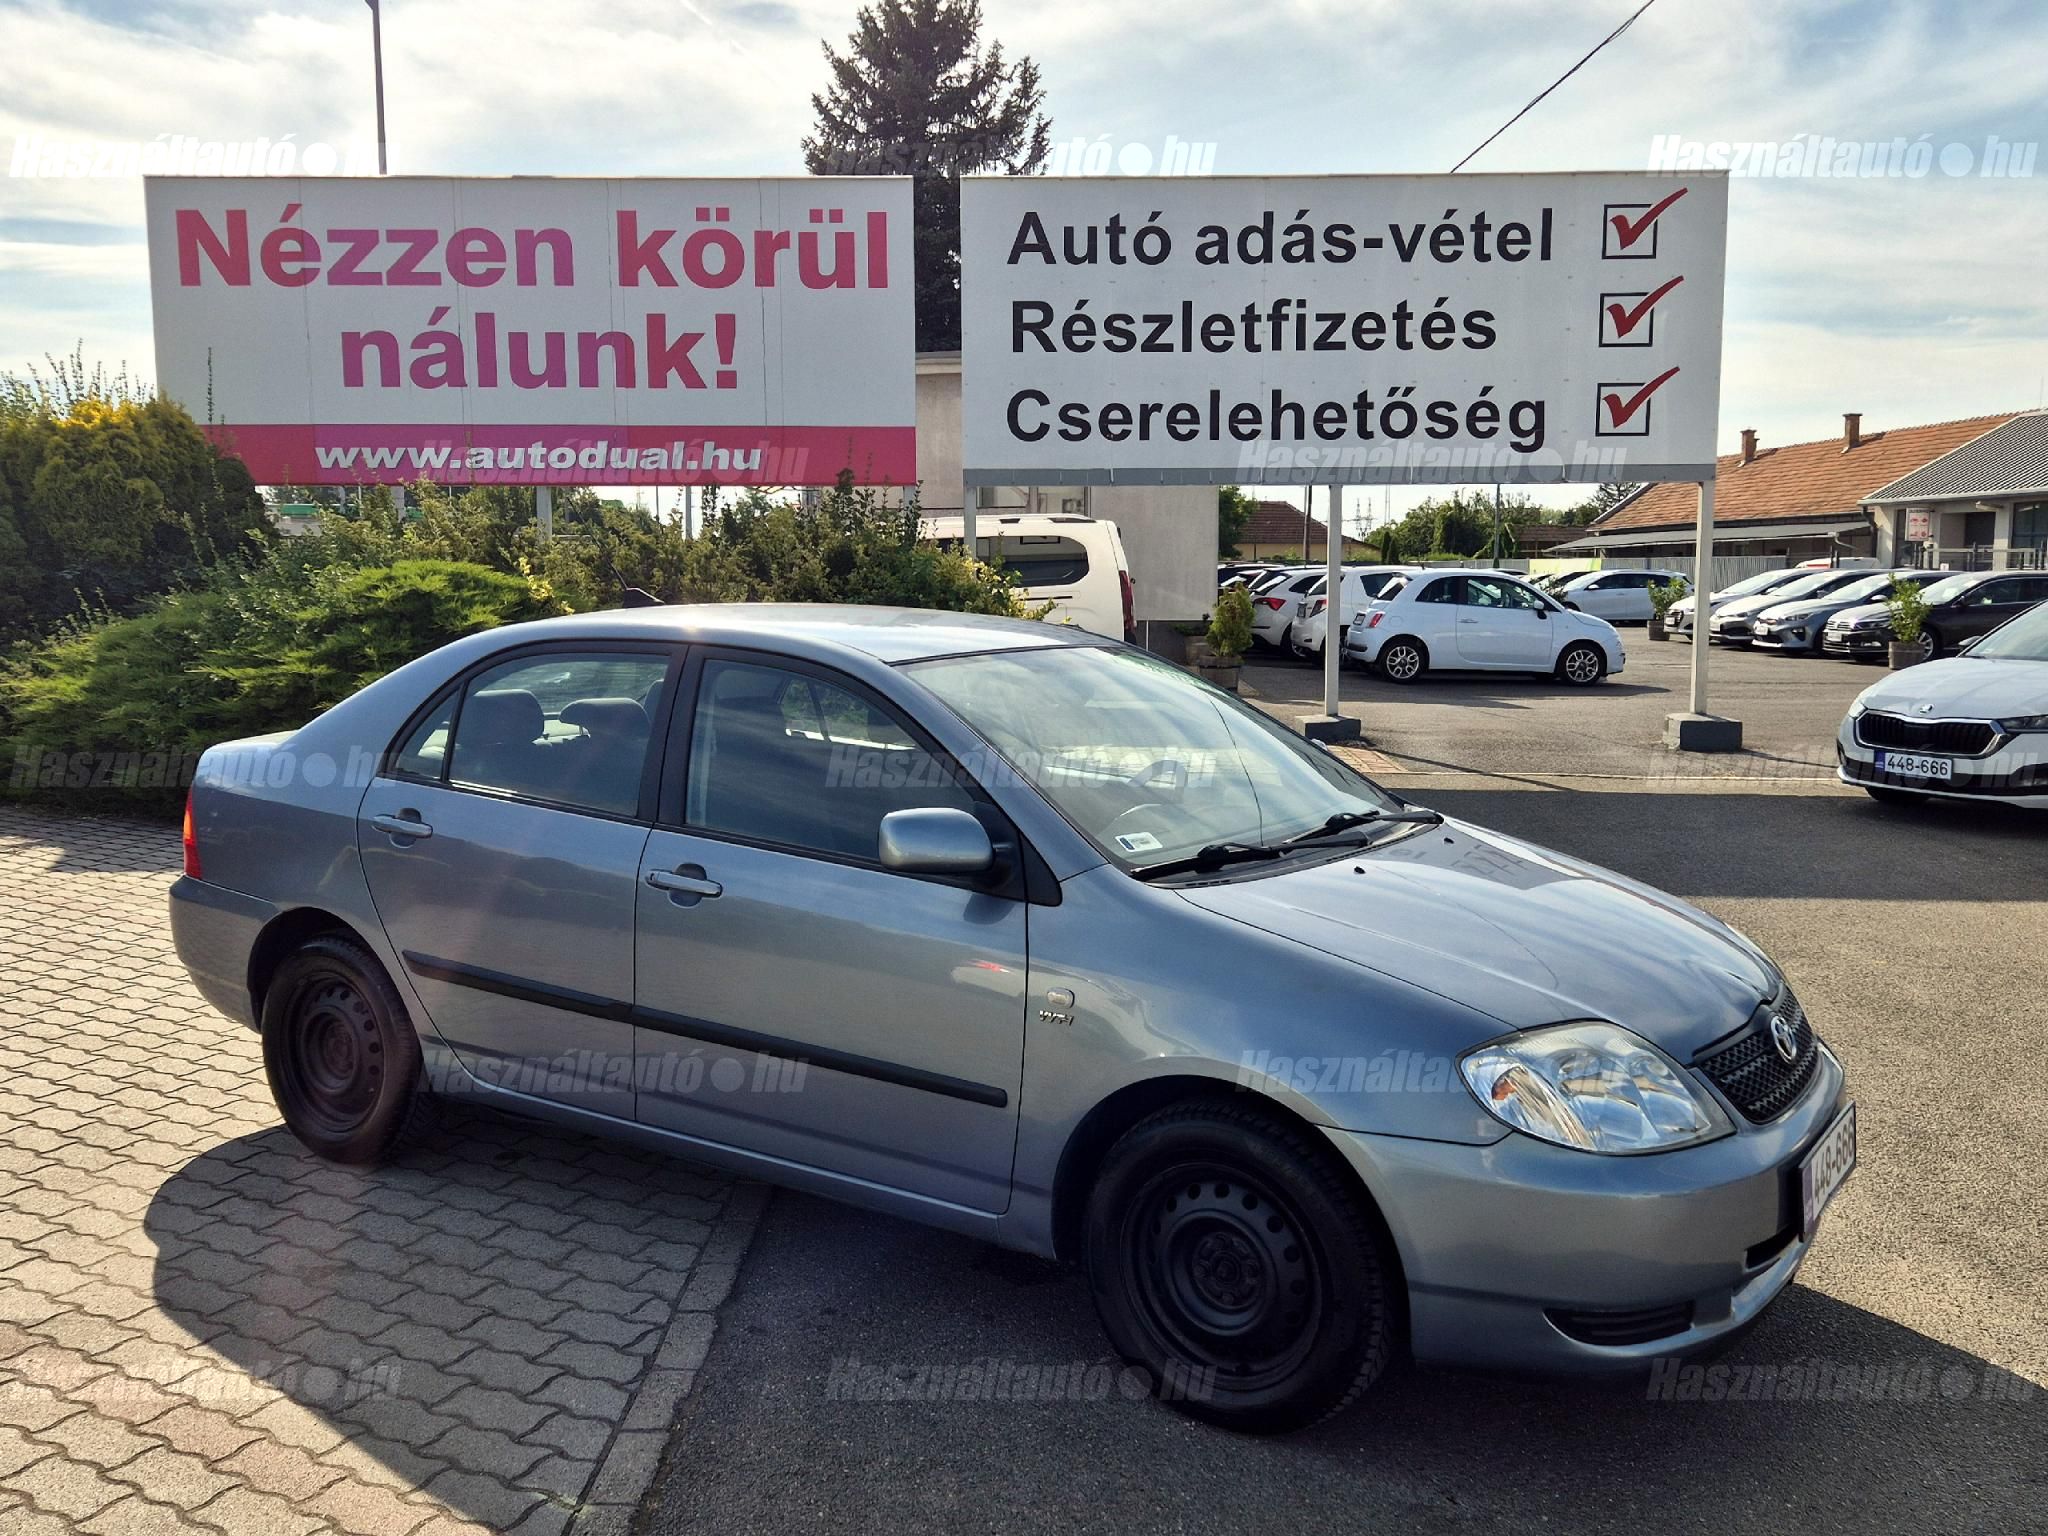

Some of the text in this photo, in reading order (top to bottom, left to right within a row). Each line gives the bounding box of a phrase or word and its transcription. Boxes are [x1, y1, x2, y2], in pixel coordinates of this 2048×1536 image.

[176, 203, 889, 290] Nézzen körül
[1007, 206, 1554, 266] Autó adás-vétel
[342, 306, 741, 391] nálunk!
[1011, 296, 1497, 354] Részletfizetés
[1006, 383, 1546, 453] Cserelehetőség
[315, 440, 763, 472] www.autodual.hu
[1887, 755, 1949, 776] 448-666
[1814, 1115, 1854, 1204] 448-666
